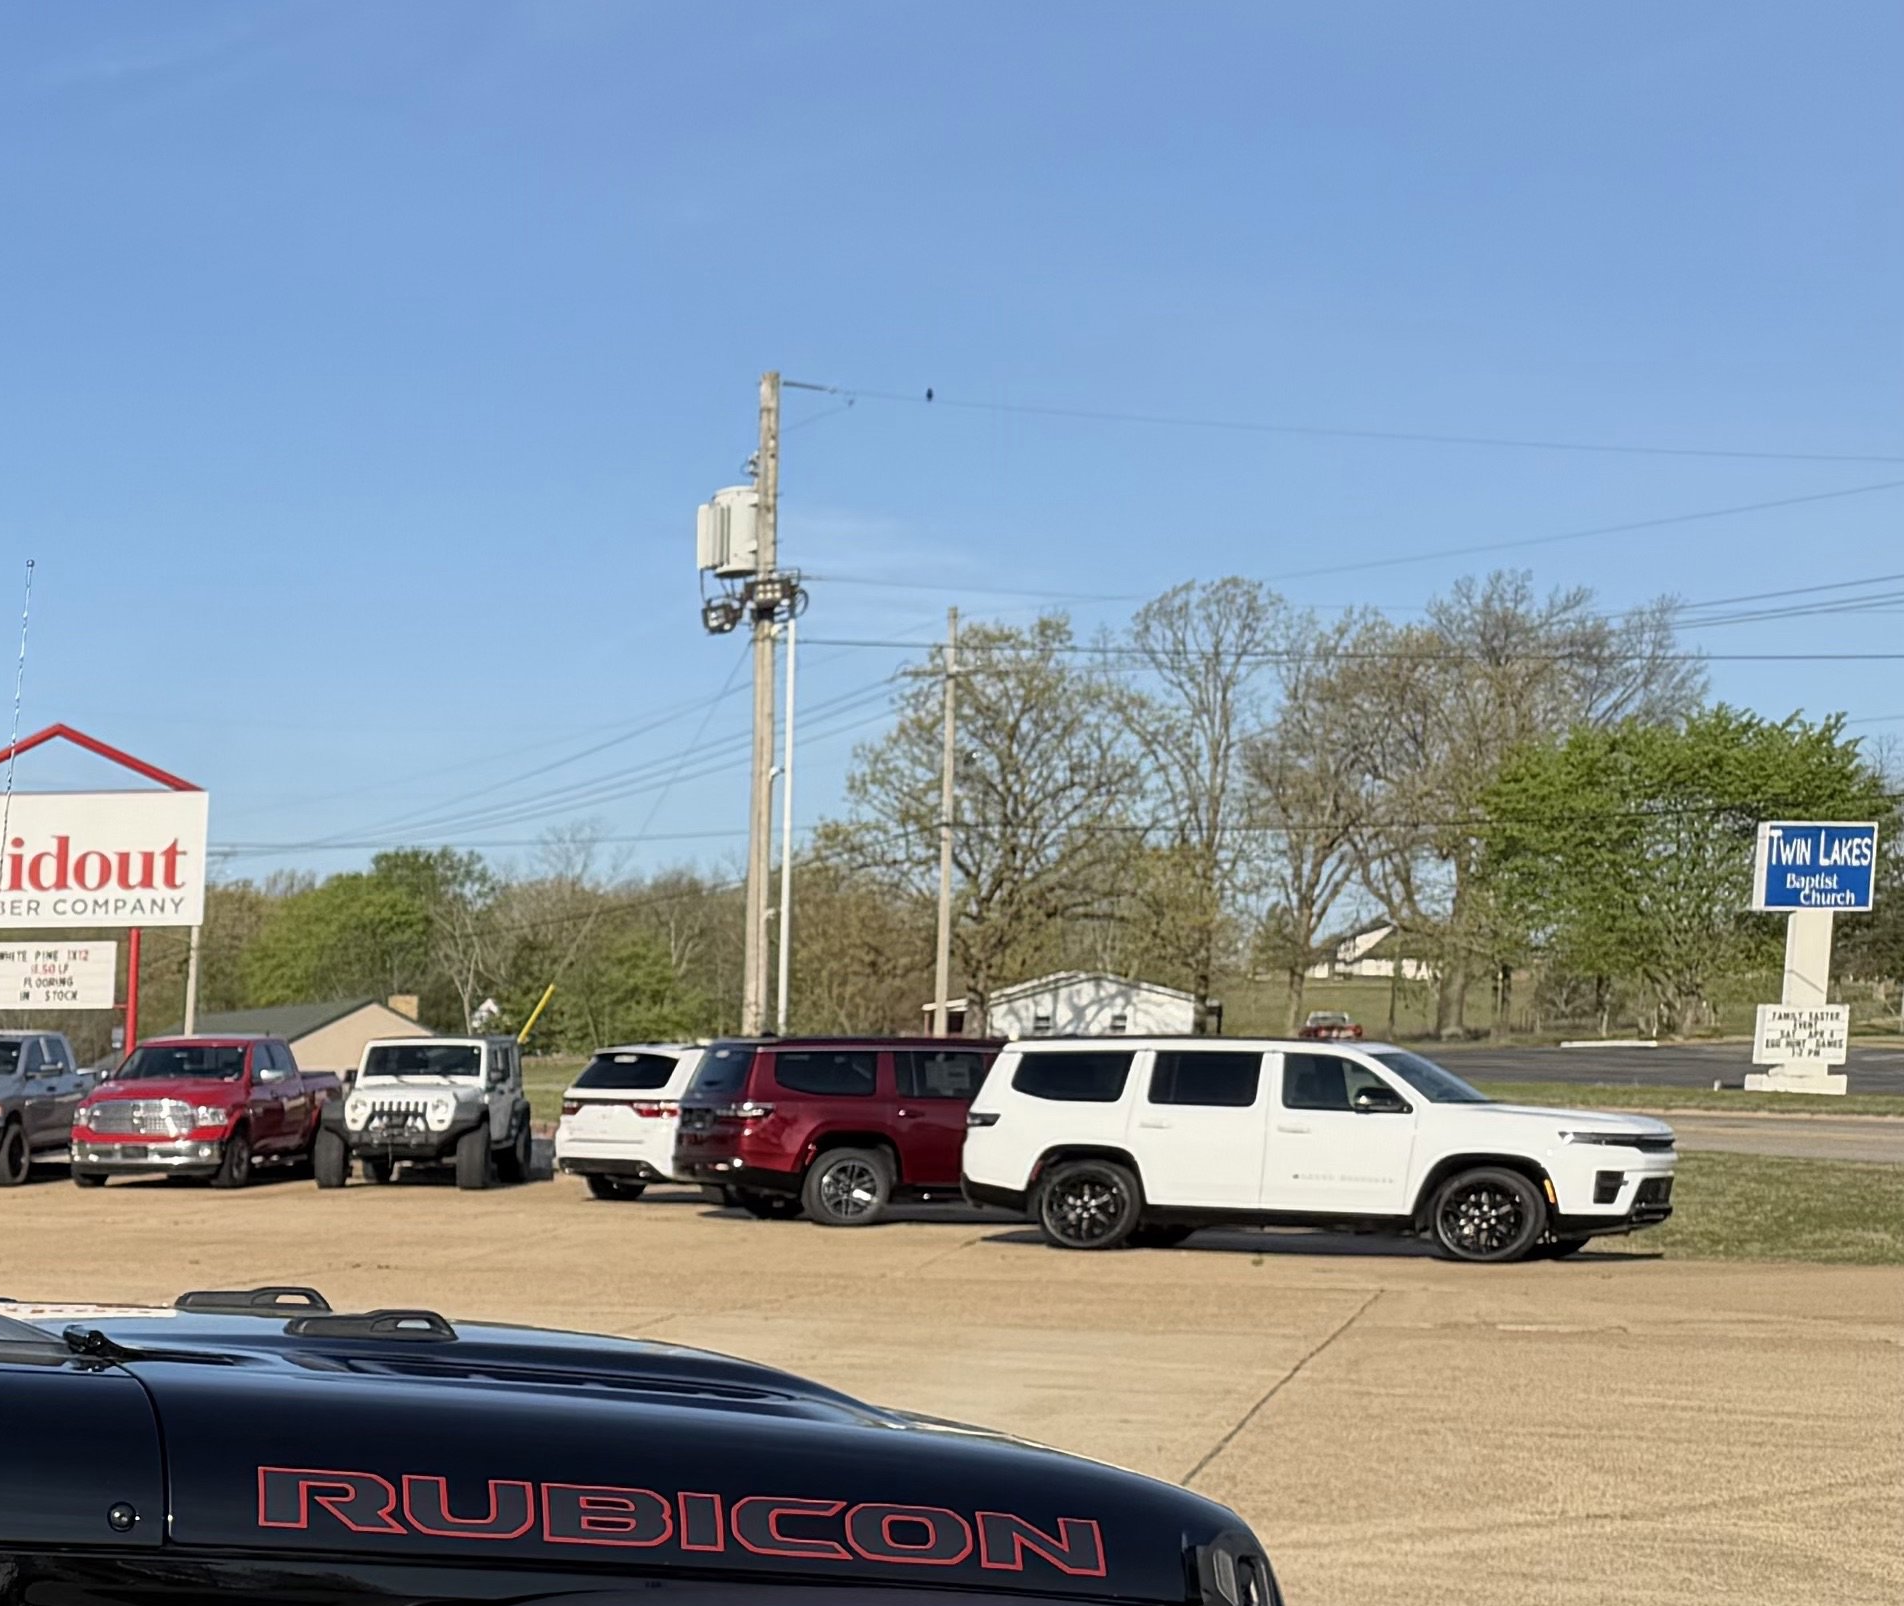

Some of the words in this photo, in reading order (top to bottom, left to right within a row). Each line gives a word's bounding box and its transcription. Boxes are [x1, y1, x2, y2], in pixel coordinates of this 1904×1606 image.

[1786, 872, 1839, 895] Baptist
[52, 896, 186, 916] COMPANY
[1799, 889, 1856, 906] Church
[35, 949, 59, 961] PINE
[257, 1466, 1107, 1577] RUBICON
